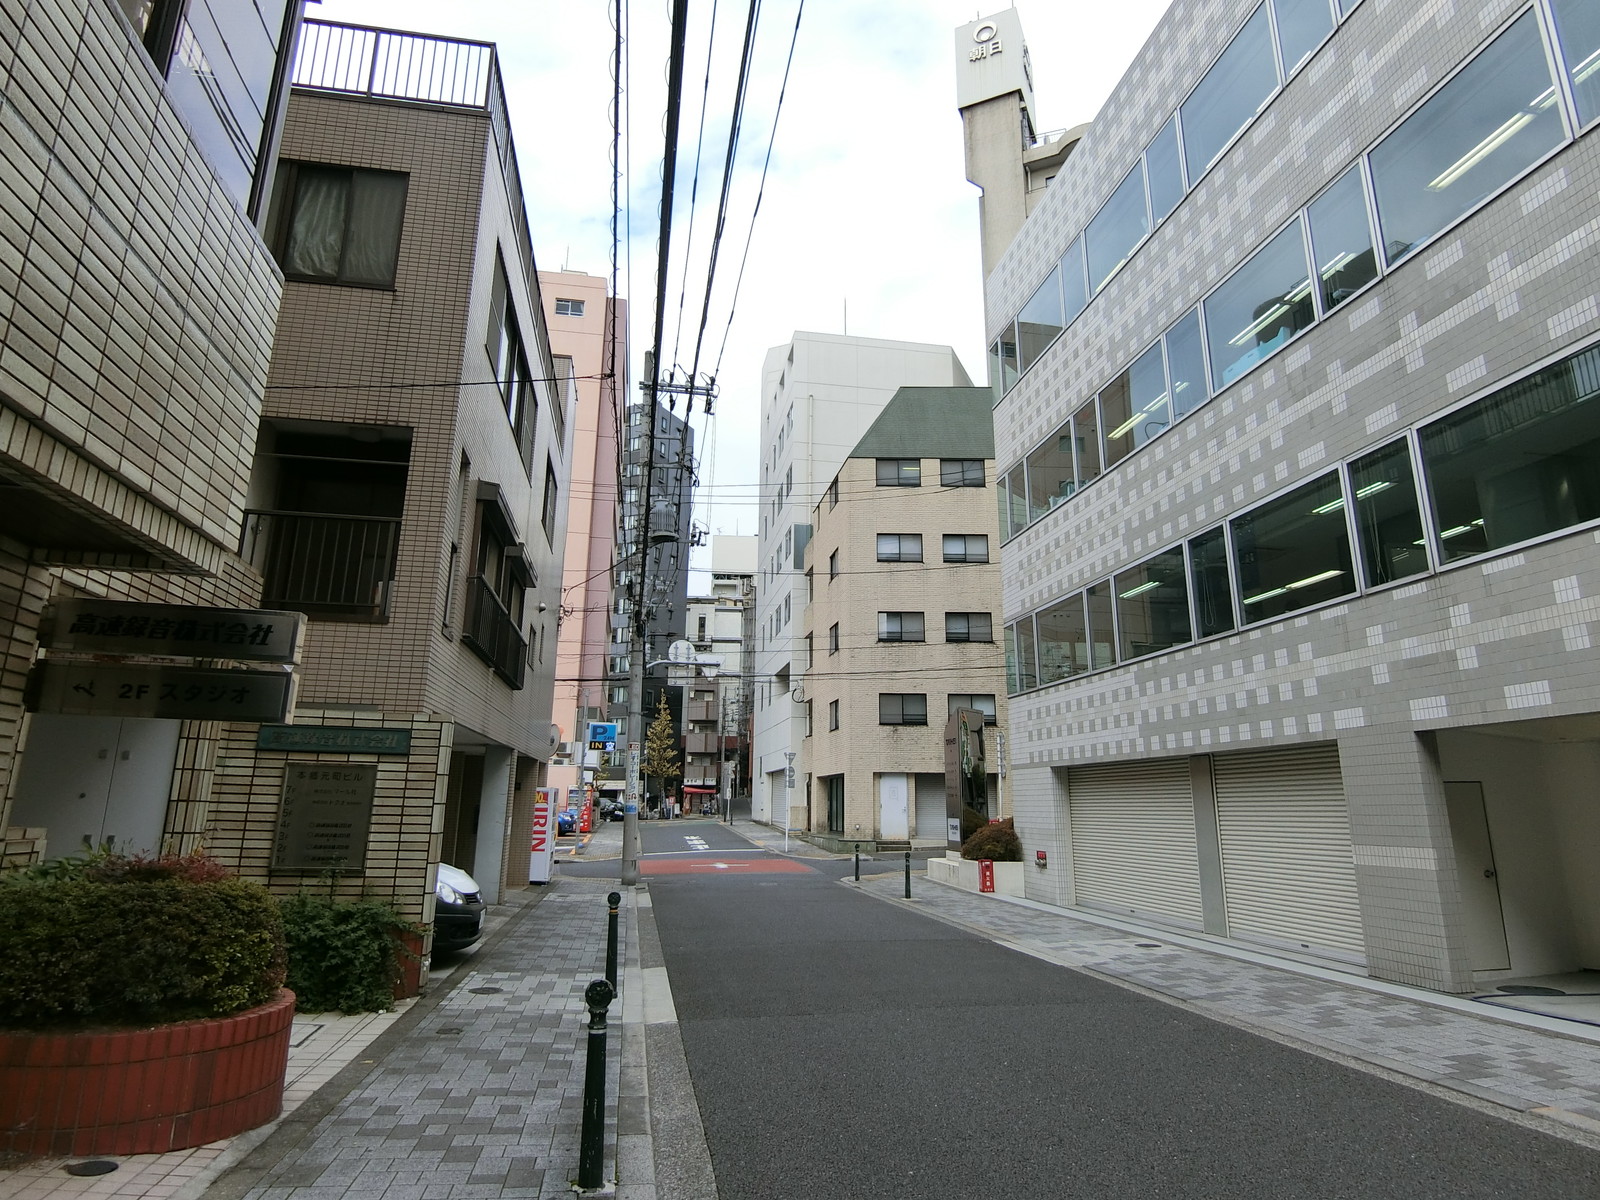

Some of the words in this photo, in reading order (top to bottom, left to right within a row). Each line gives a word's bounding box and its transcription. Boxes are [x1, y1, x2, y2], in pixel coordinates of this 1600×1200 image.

[969, 40, 1003, 62] 朝日
[68, 612, 274, 646] 高速録音株式会社
[117, 683, 151, 701] 2F
[158, 683, 251, 705] スタジオ
[531, 804, 549, 852] IRIN
